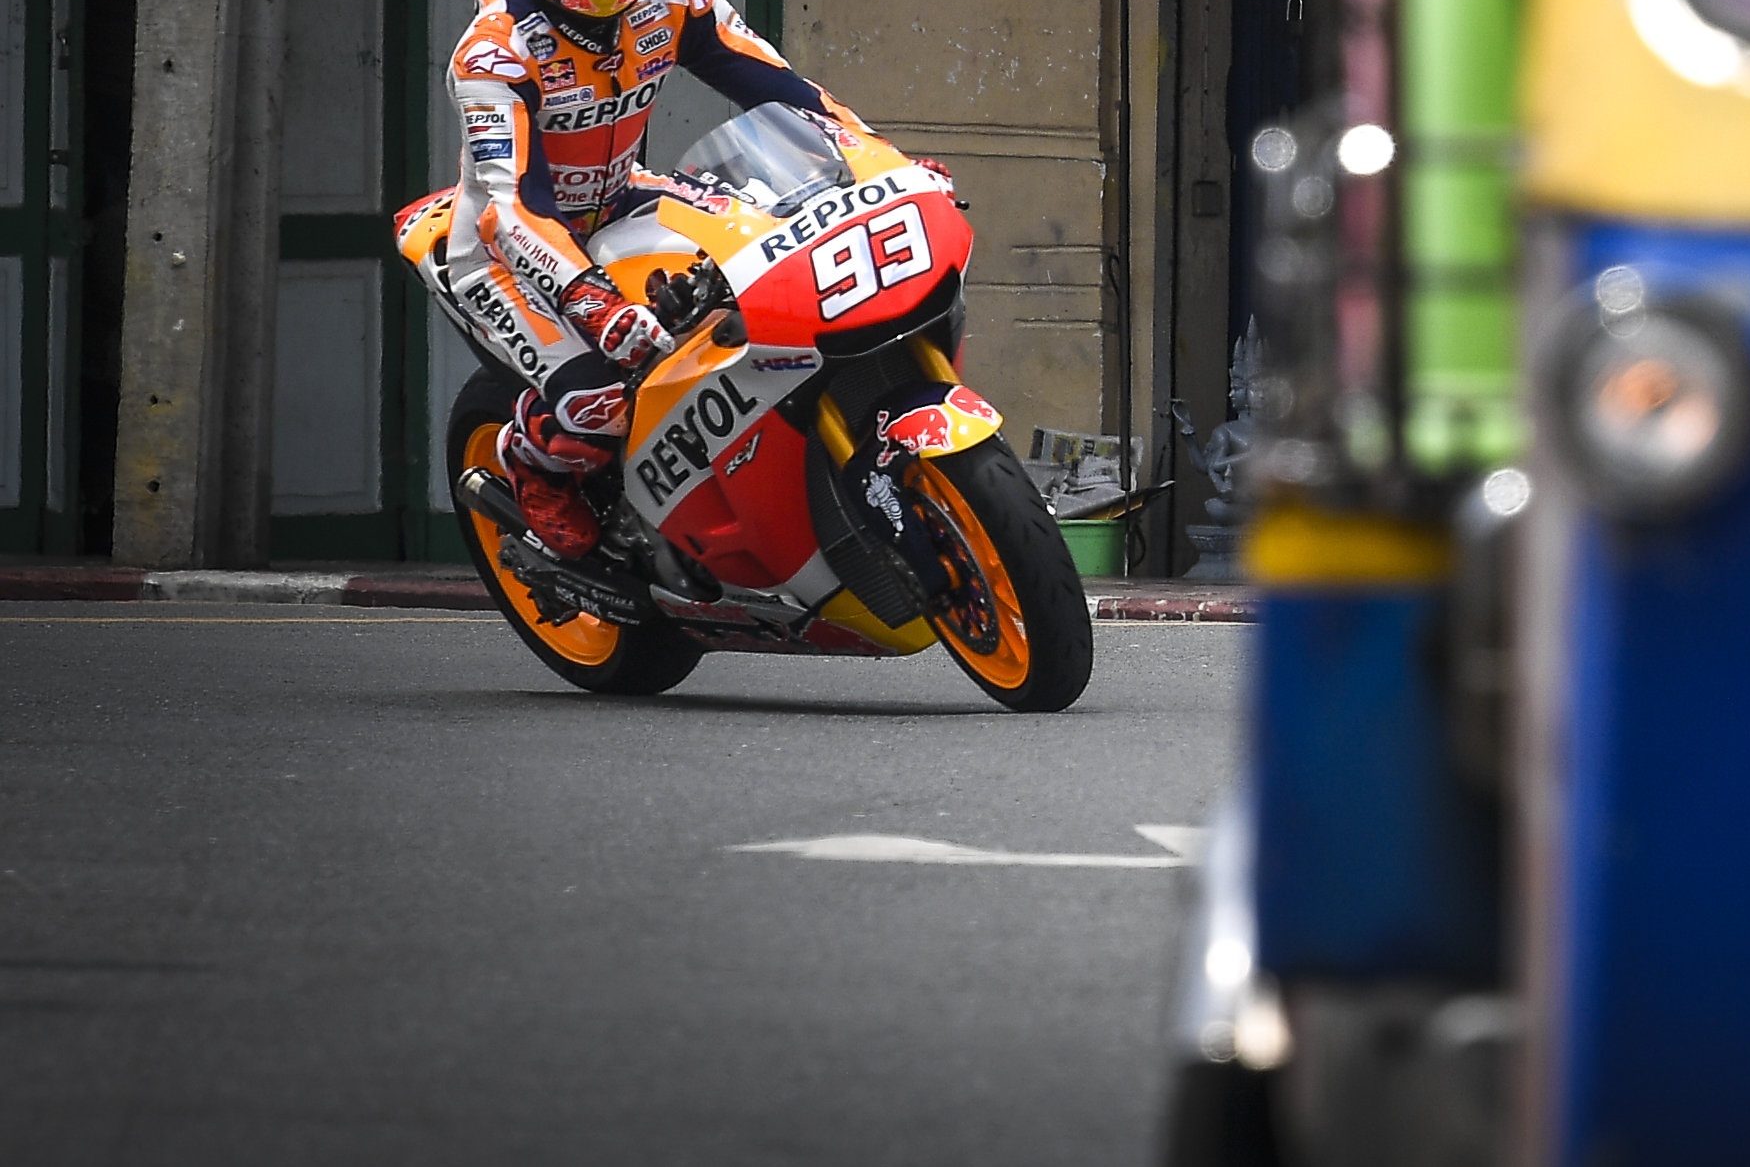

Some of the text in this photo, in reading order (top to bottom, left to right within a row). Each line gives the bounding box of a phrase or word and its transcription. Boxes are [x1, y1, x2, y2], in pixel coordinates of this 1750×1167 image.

[631, 1, 666, 25] REPSOL
[559, 22, 604, 53] REPSOL
[637, 28, 671, 55] SHOEI
[543, 92, 578, 108] Allianz
[464, 113, 507, 125] EPSOL
[555, 189, 586, 202] One
[760, 175, 907, 263] REPSOL
[507, 224, 531, 255] Satu
[810, 200, 933, 323] 93
[752, 354, 817, 372] HRC
